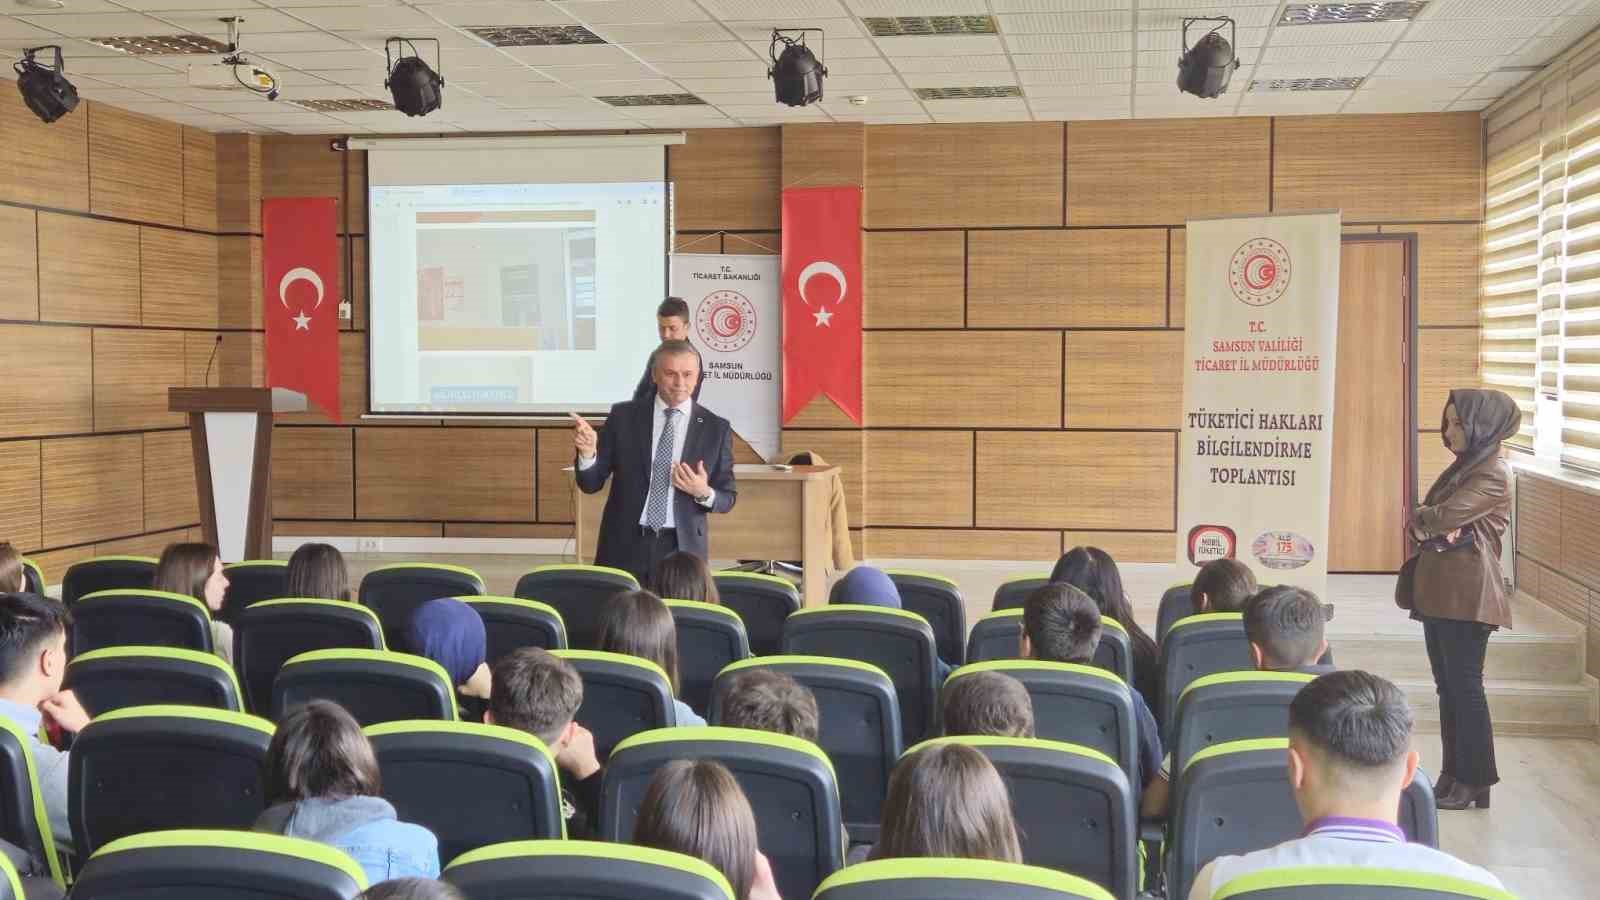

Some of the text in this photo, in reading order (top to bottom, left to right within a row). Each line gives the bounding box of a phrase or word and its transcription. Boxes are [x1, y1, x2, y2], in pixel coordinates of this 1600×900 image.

[720, 265, 733, 273] T.C.
[692, 272, 761, 281] TİCARET BAKANLIĞI
[1248, 321, 1267, 333] T.C.
[1212, 337, 1303, 353] SAMSUN VALİLİĞİ
[708, 362, 743, 370] SAMSUN
[1194, 356, 1320, 371] TİCARET İL MÜDÜRLÜĞÜ
[714, 371, 721, 379] İL
[722, 371, 773, 381] MÜDÜRLÜĞÜ
[1188, 408, 1323, 431] TÜKETİCİ HAKLARI
[1196, 435, 1312, 459] BİLGİLENDİRME
[1209, 467, 1296, 487] TOPLANTISI
